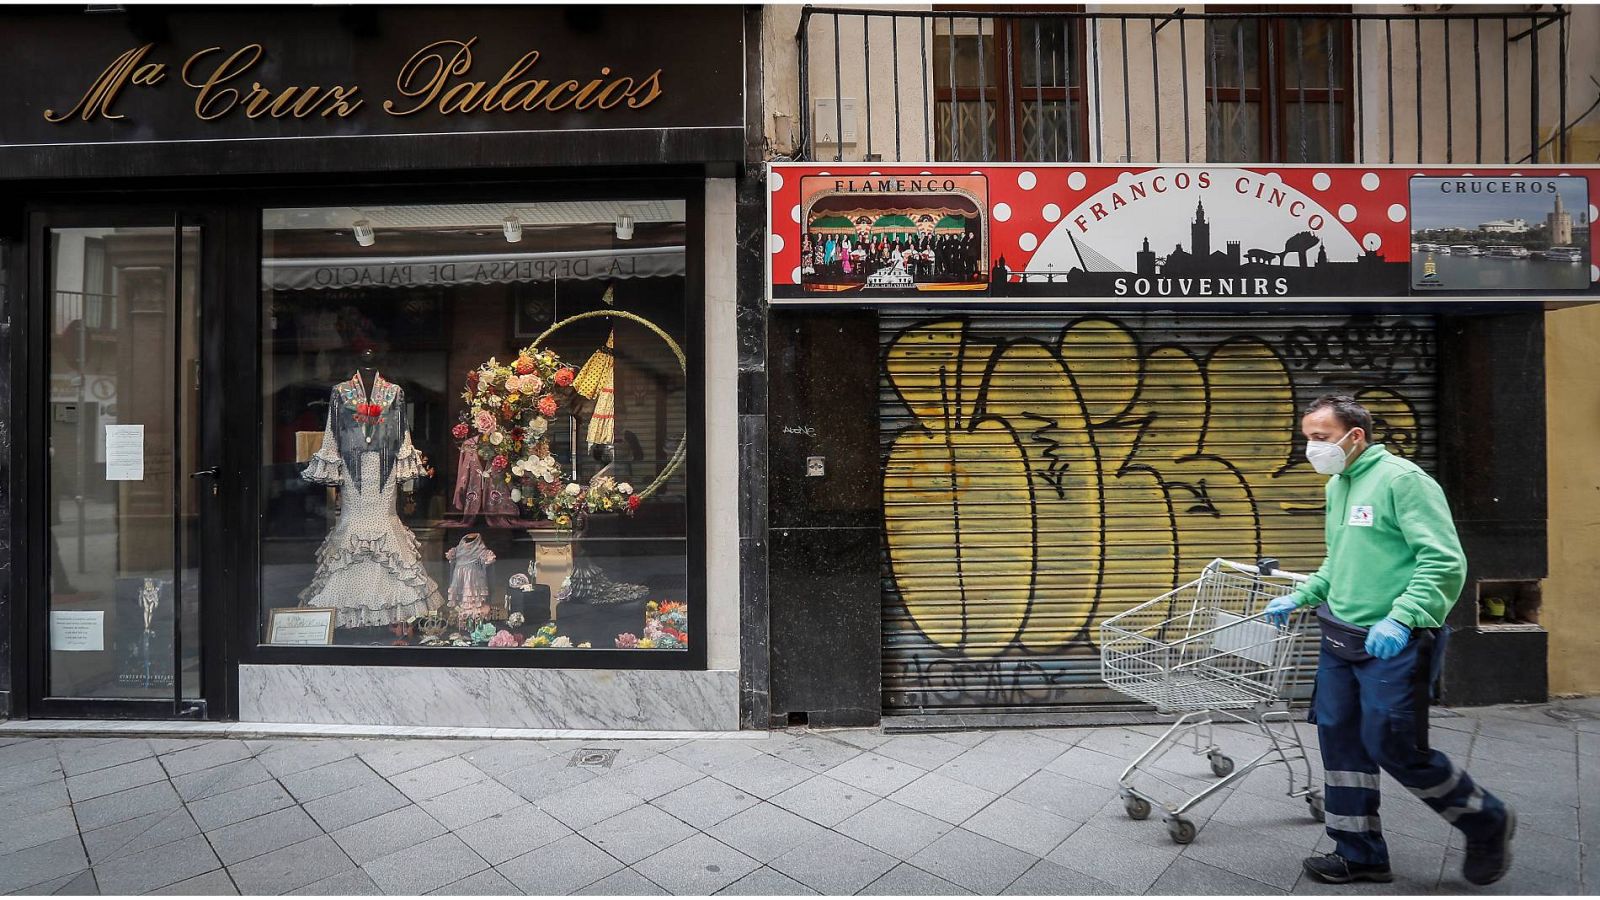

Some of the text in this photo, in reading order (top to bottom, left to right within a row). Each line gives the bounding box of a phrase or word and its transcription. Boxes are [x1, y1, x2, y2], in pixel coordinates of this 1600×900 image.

[181, 43, 362, 120] Cruz
[383, 36, 663, 116] Palacios
[835, 180, 956, 193] FLAMENCO
[1441, 181, 1557, 194] CRUCEROS
[1074, 172, 1324, 233] FRANCOS CINCO
[1113, 277, 1290, 297] SOUVENIRS
